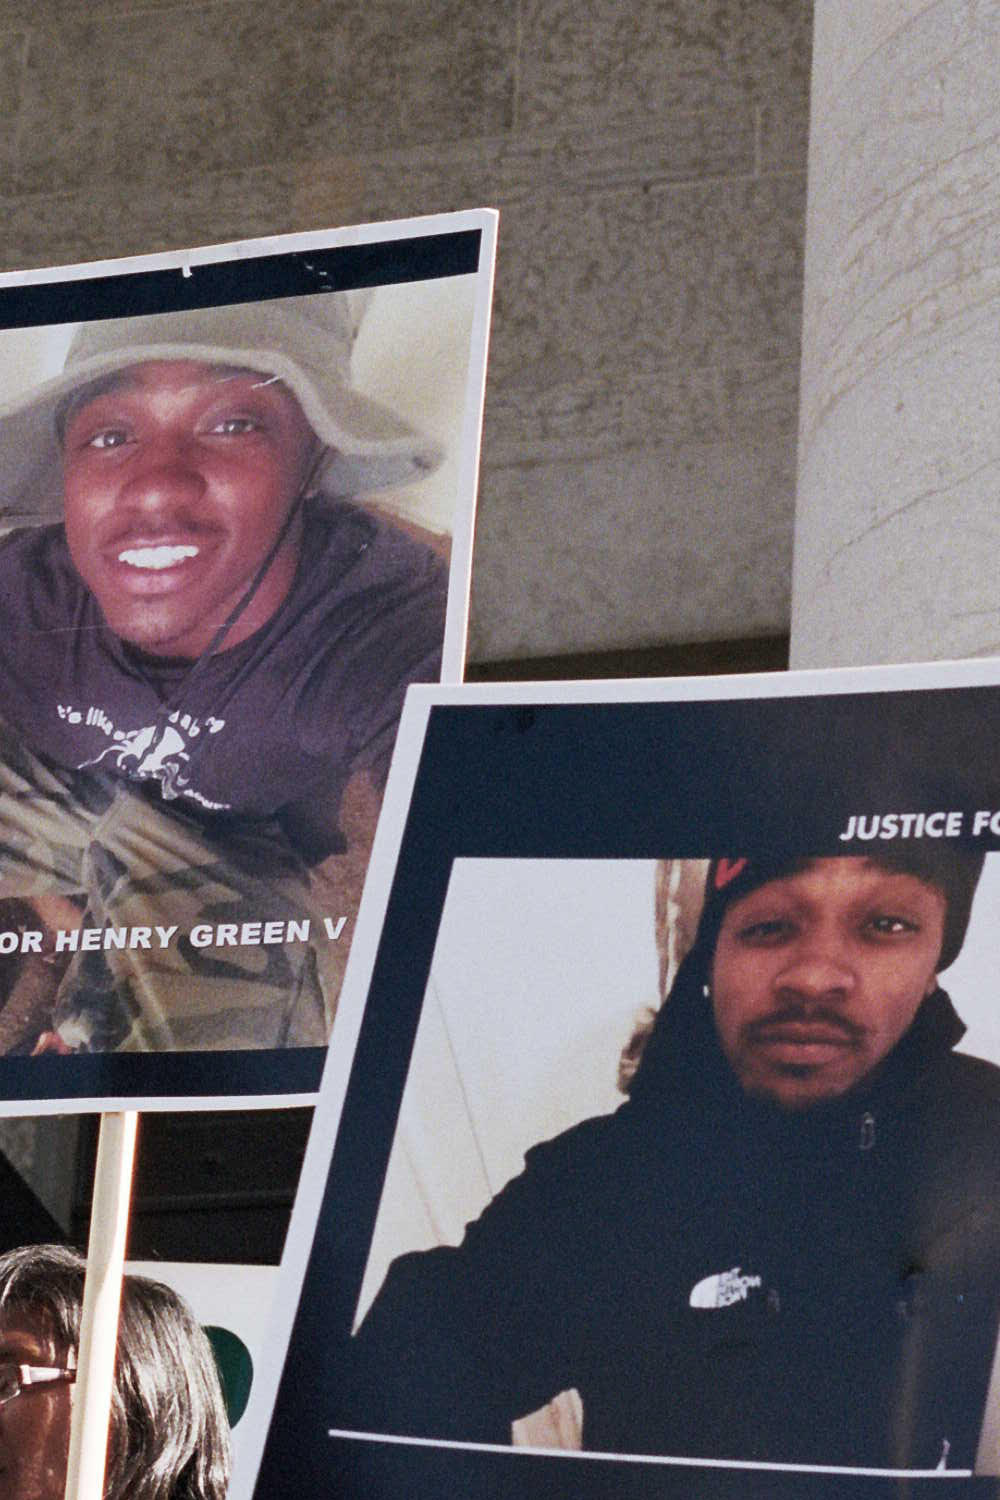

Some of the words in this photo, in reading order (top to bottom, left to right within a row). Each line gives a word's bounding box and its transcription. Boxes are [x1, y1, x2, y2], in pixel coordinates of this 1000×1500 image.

[839, 812, 964, 841] JUSTICE
[55, 926, 178, 952] HENRY
[189, 919, 311, 949] GREEN
[324, 916, 348, 941] V
